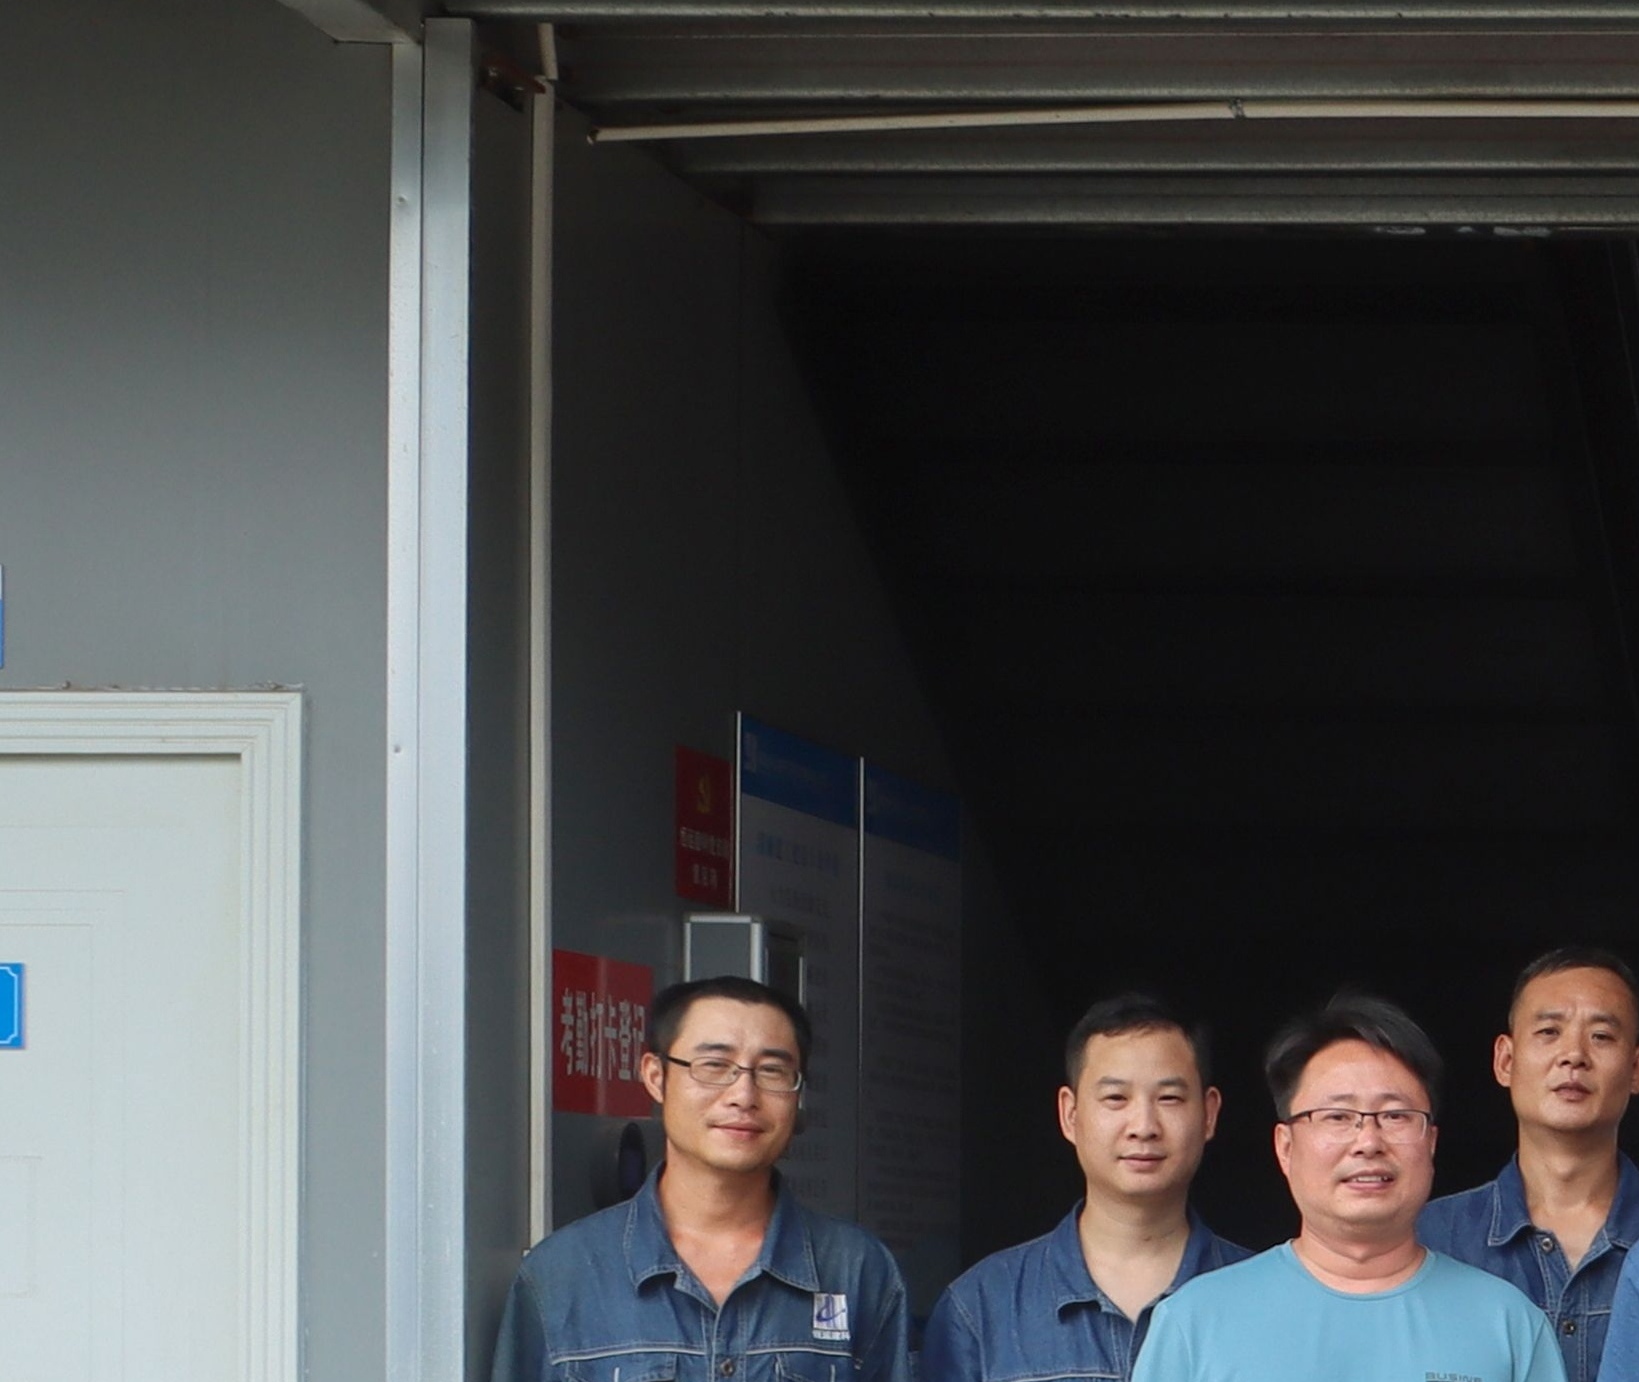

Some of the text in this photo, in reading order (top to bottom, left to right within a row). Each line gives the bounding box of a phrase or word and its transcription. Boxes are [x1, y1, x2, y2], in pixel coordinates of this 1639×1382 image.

[560, 985, 647, 1082] 考勤打卡登记
